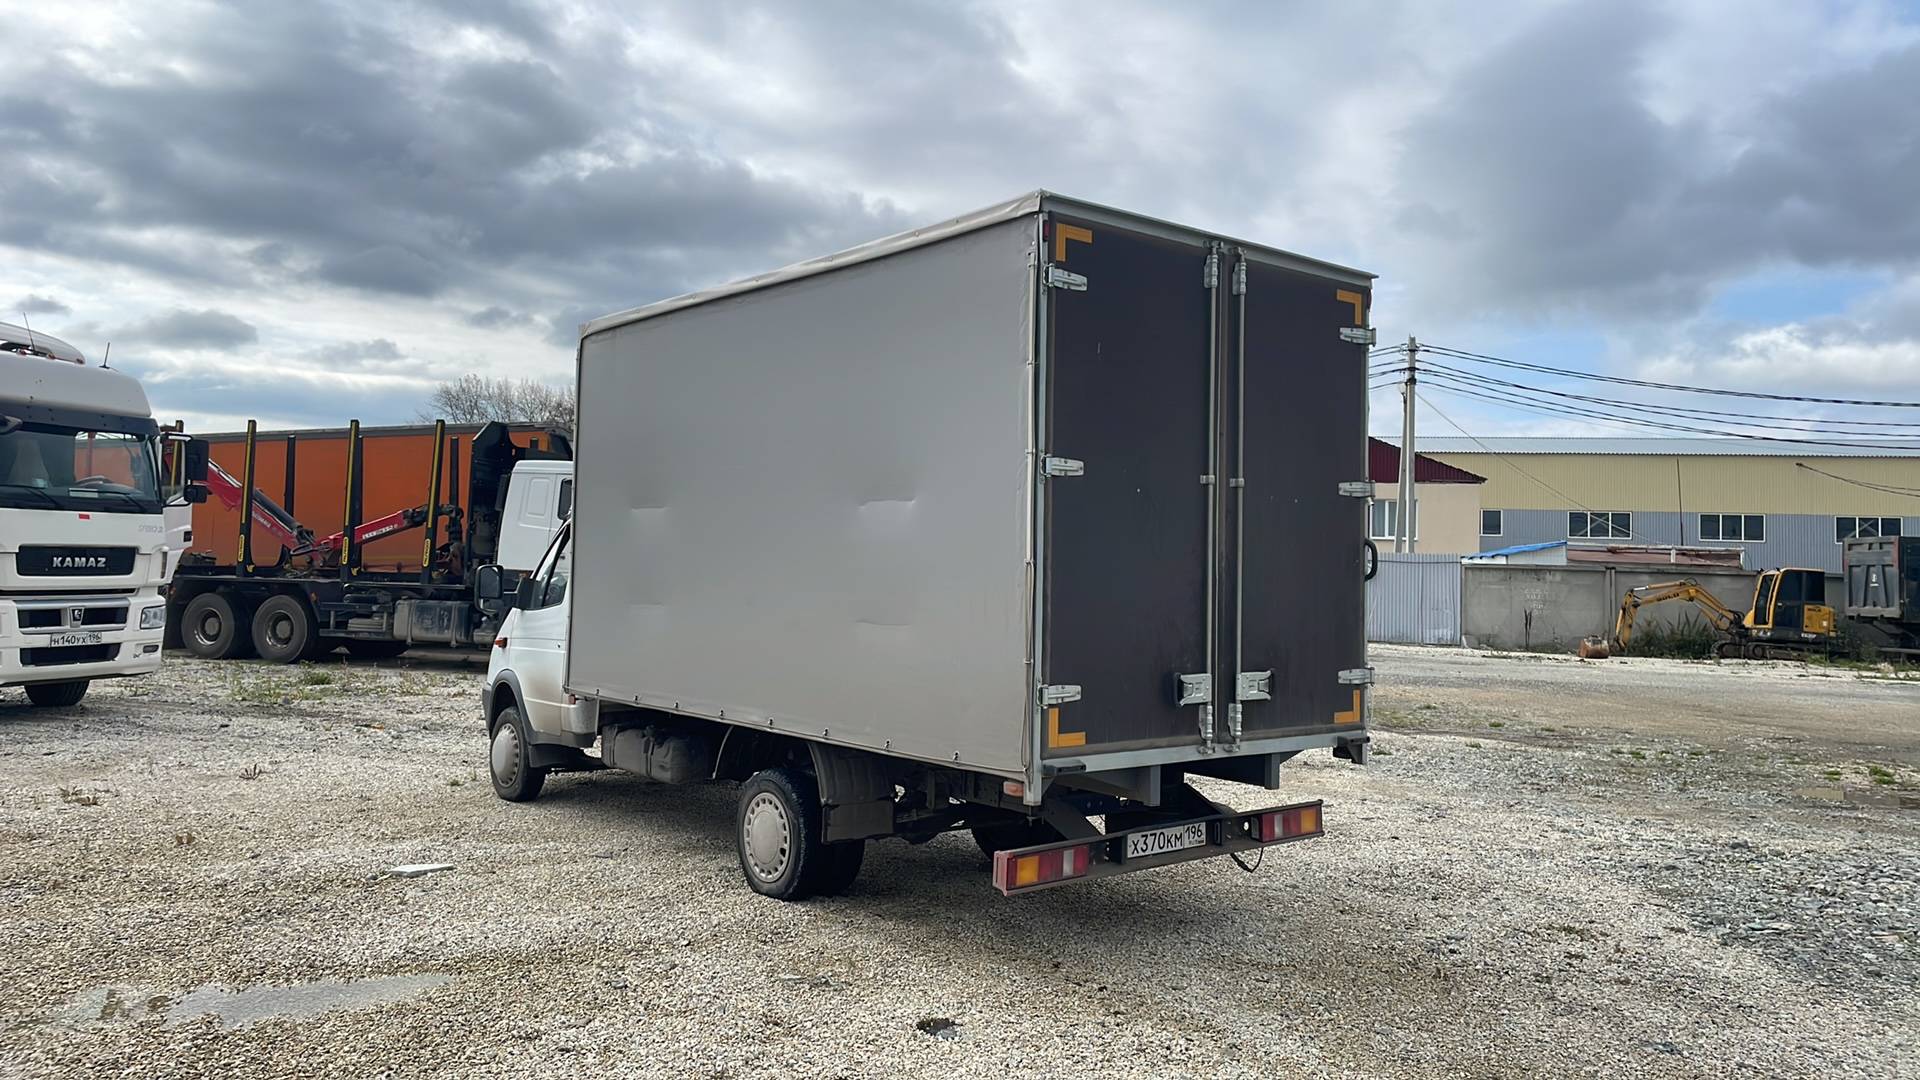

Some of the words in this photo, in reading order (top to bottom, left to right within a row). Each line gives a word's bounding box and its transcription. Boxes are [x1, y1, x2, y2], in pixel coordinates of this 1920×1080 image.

[52, 556, 107, 568] KAMAZ
[1131, 831, 1183, 855] Х370КМ
[1184, 823, 1203, 840] 196
